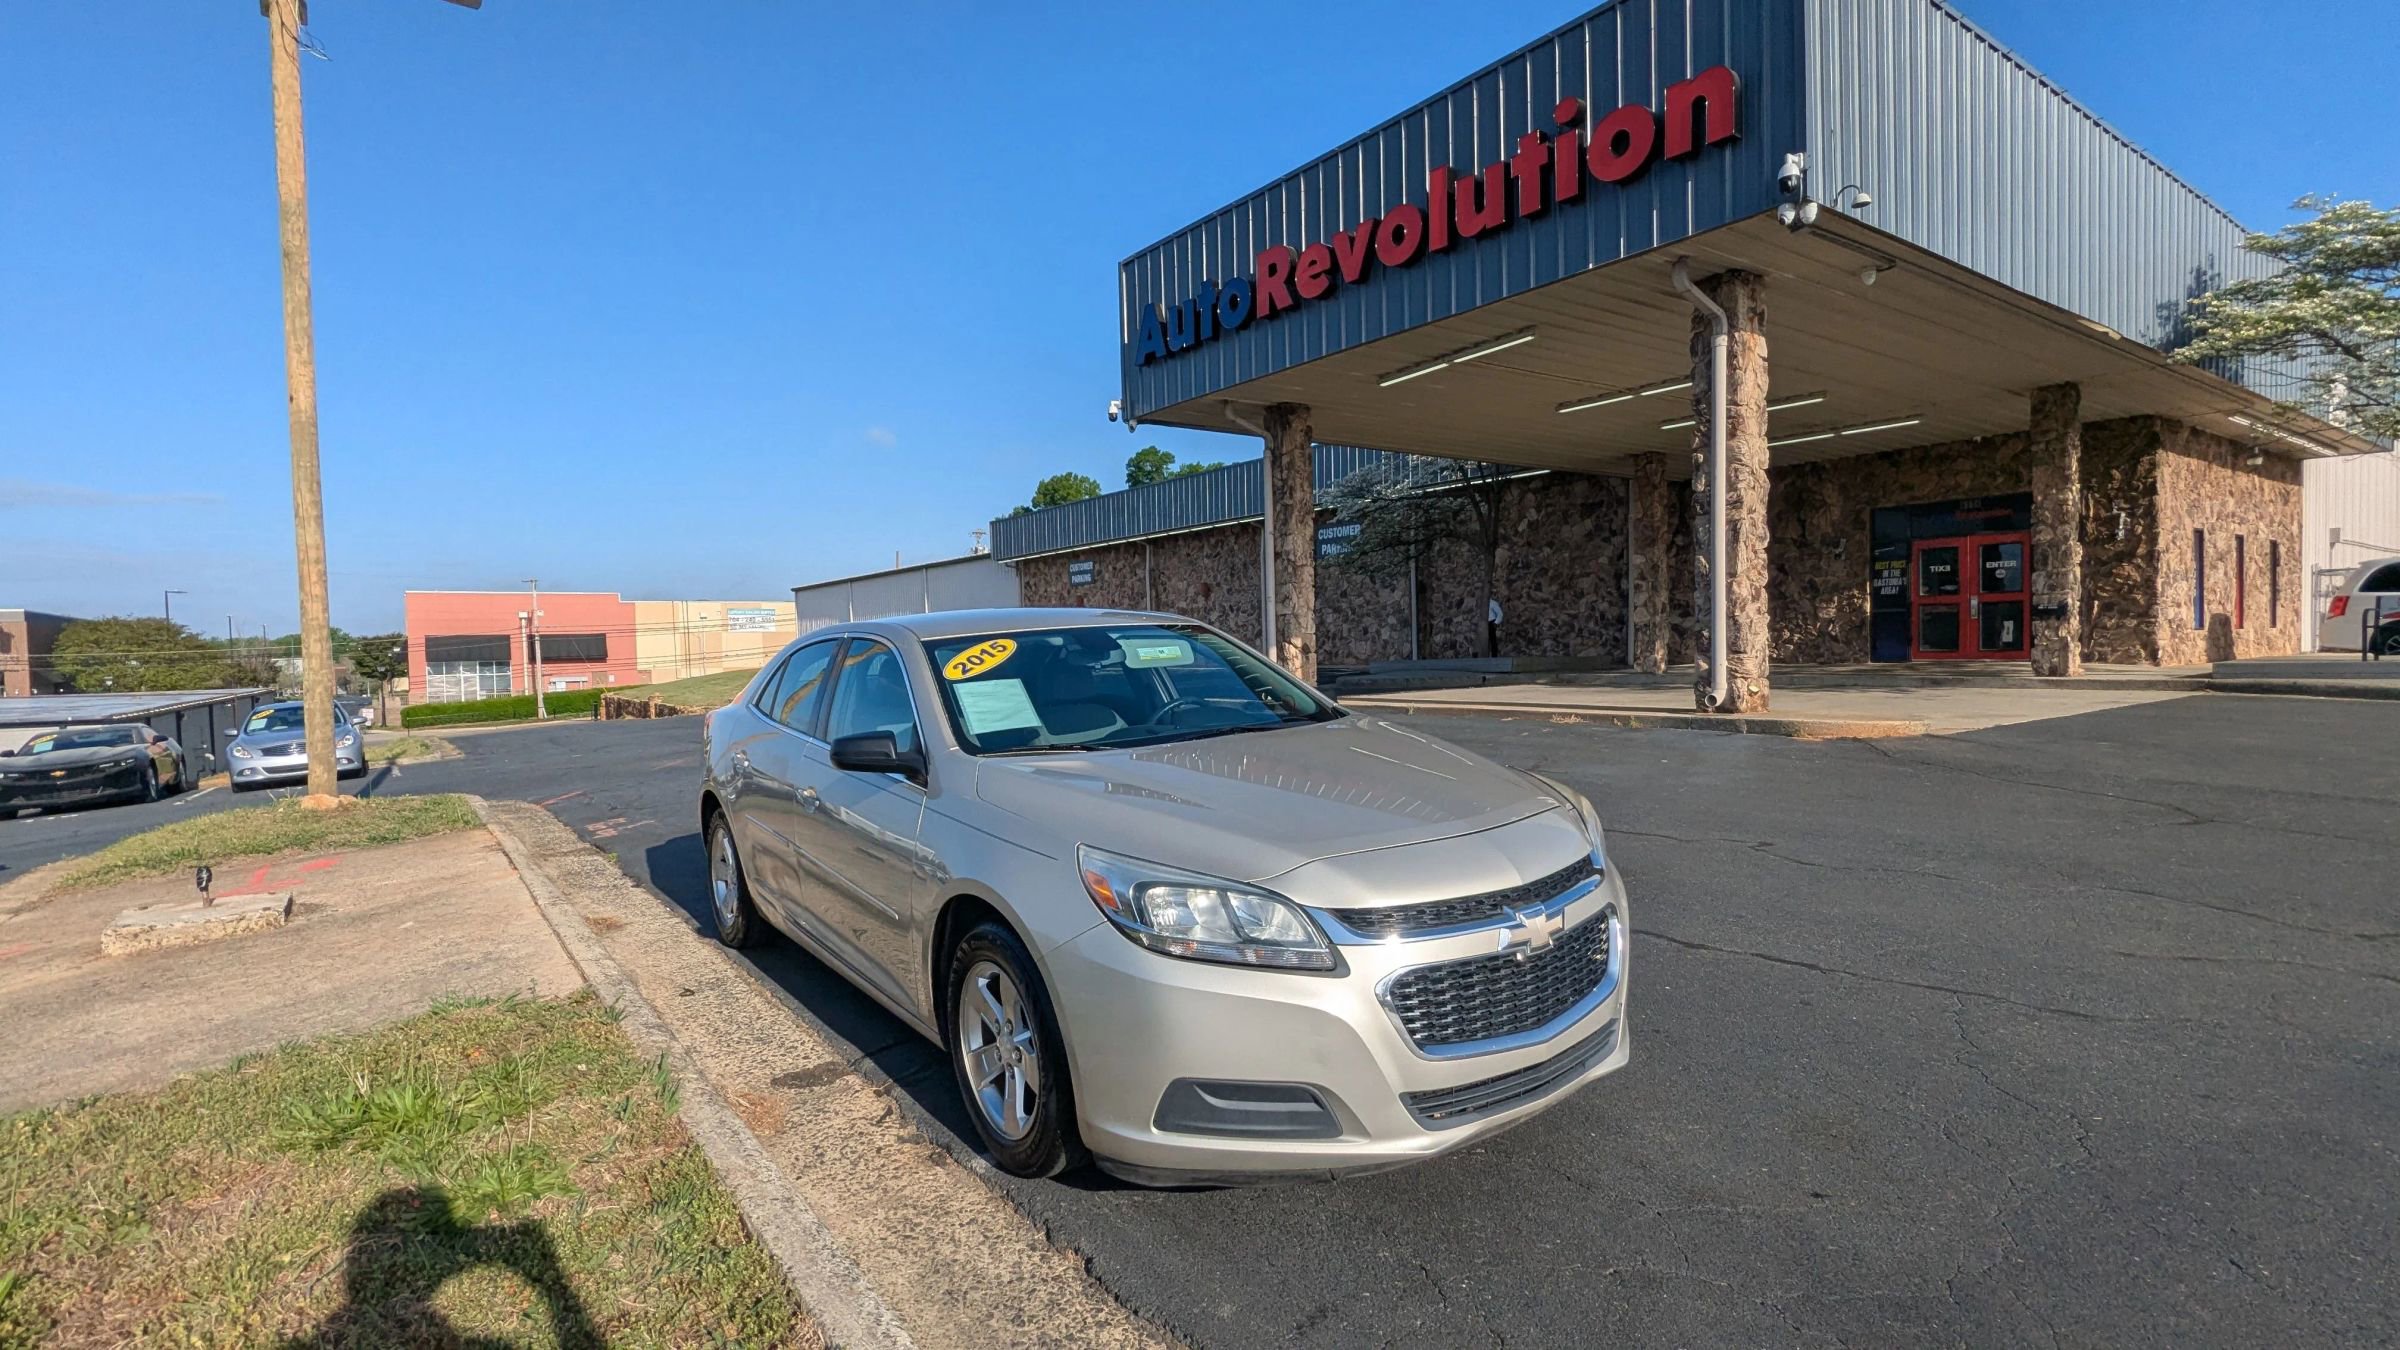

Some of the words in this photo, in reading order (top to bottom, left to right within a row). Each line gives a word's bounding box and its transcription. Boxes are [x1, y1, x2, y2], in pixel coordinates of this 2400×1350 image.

[1318, 524, 1361, 539] CUSTOMER
[1070, 561, 1093, 572] CUSTOMER
[1986, 560, 2016, 568] ENTER
[1890, 569, 1901, 577] THE
[1072, 574, 1091, 583] PARKING
[953, 642, 1007, 675] 2015
